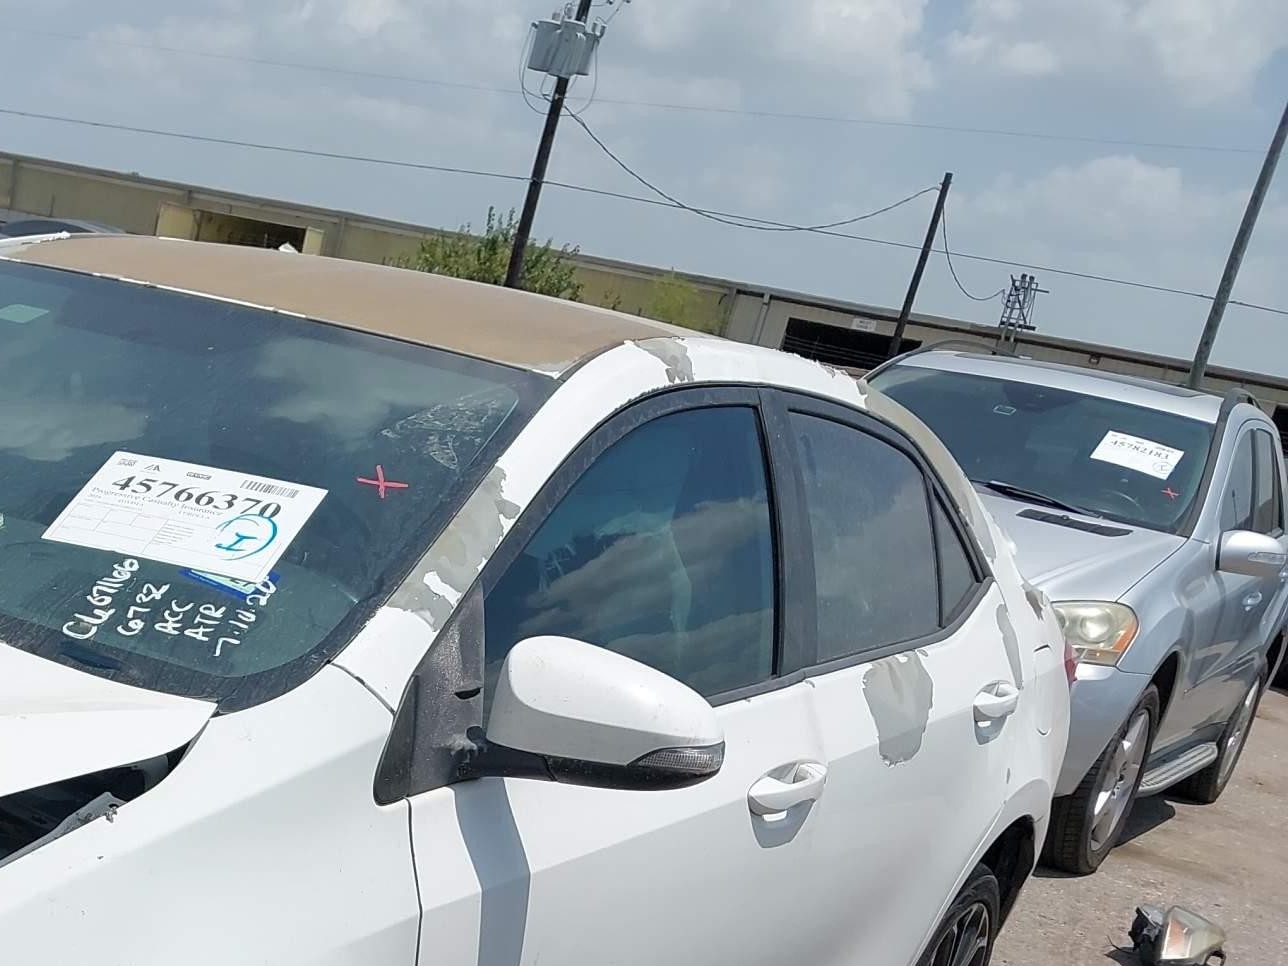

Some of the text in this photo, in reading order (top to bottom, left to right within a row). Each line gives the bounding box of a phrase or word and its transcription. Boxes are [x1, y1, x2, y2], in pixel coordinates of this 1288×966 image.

[112, 475, 282, 520] 45766370
[154, 599, 195, 635] ACC
[183, 603, 227, 641] ATR
